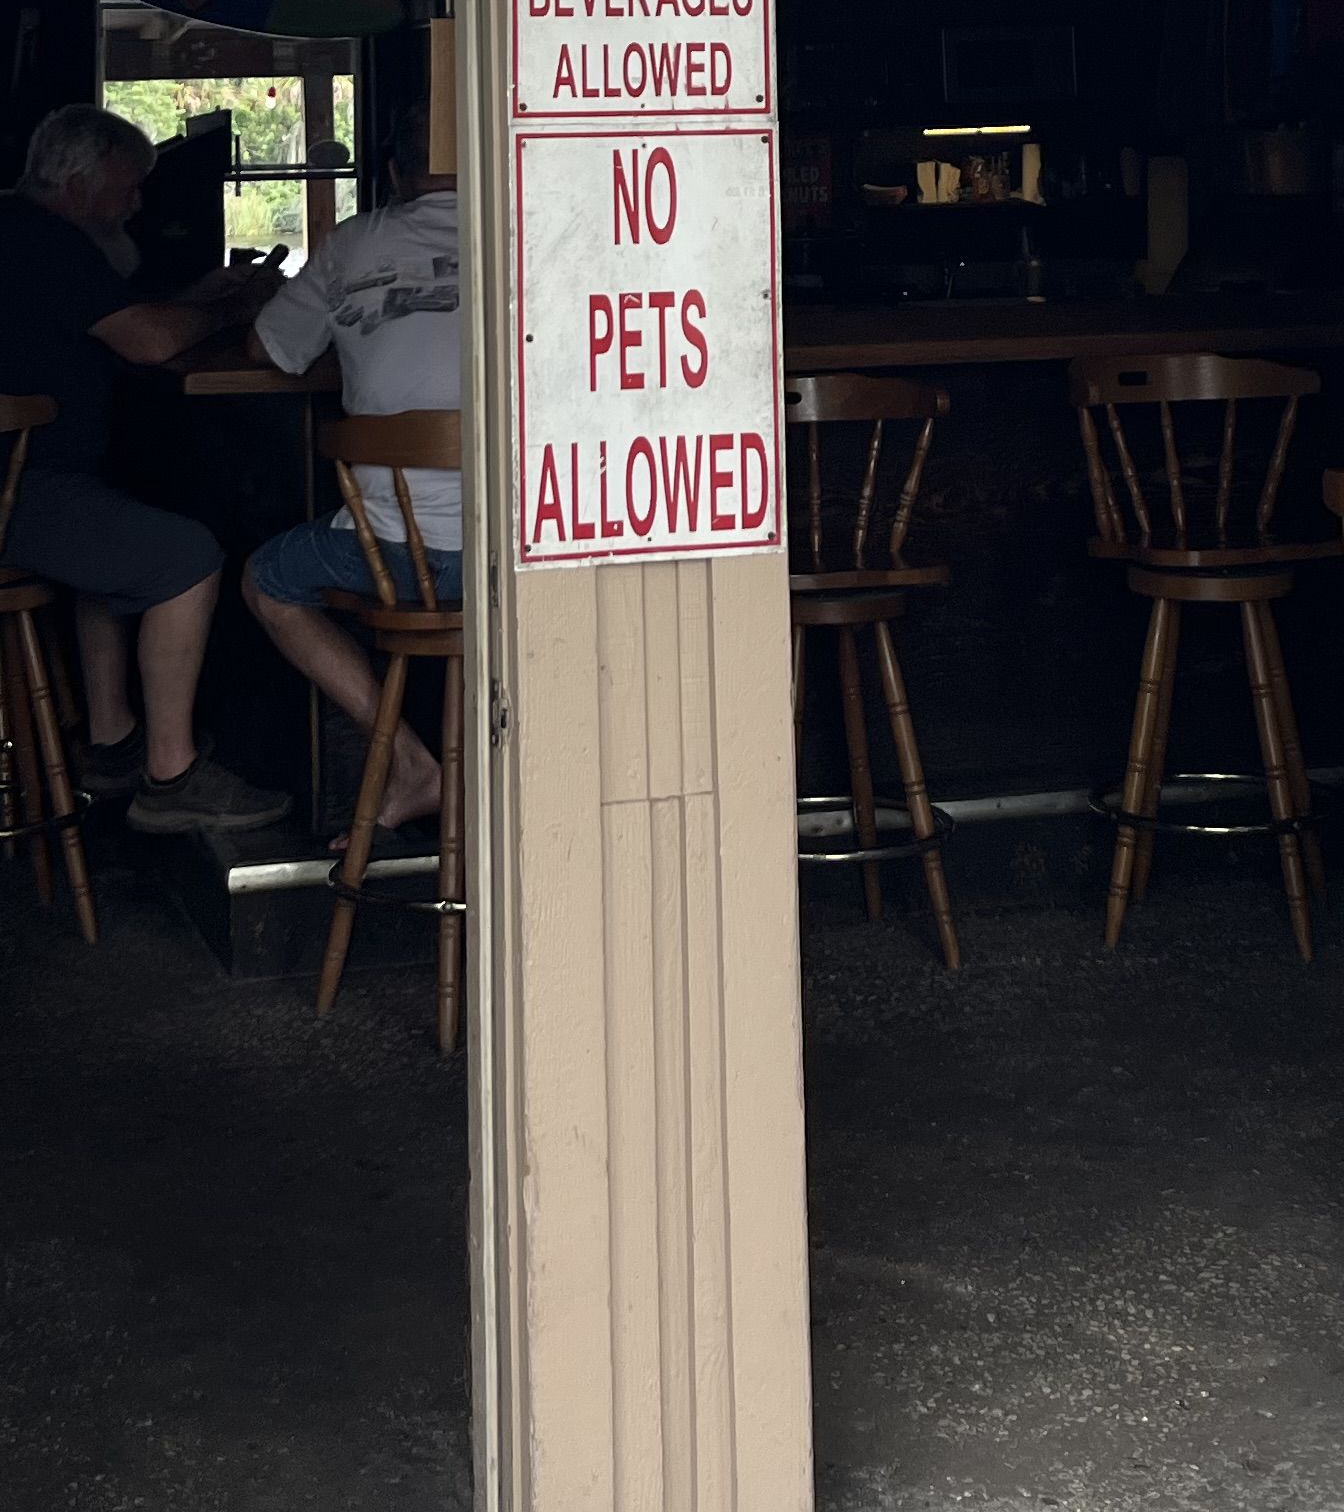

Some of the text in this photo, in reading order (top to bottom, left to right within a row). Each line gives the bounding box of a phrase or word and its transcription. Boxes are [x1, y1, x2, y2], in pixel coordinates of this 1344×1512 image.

[552, 42, 733, 99] ALLOWED
[613, 146, 678, 246] NO
[589, 288, 709, 392] PETS
[532, 432, 769, 544] ALLOWED
